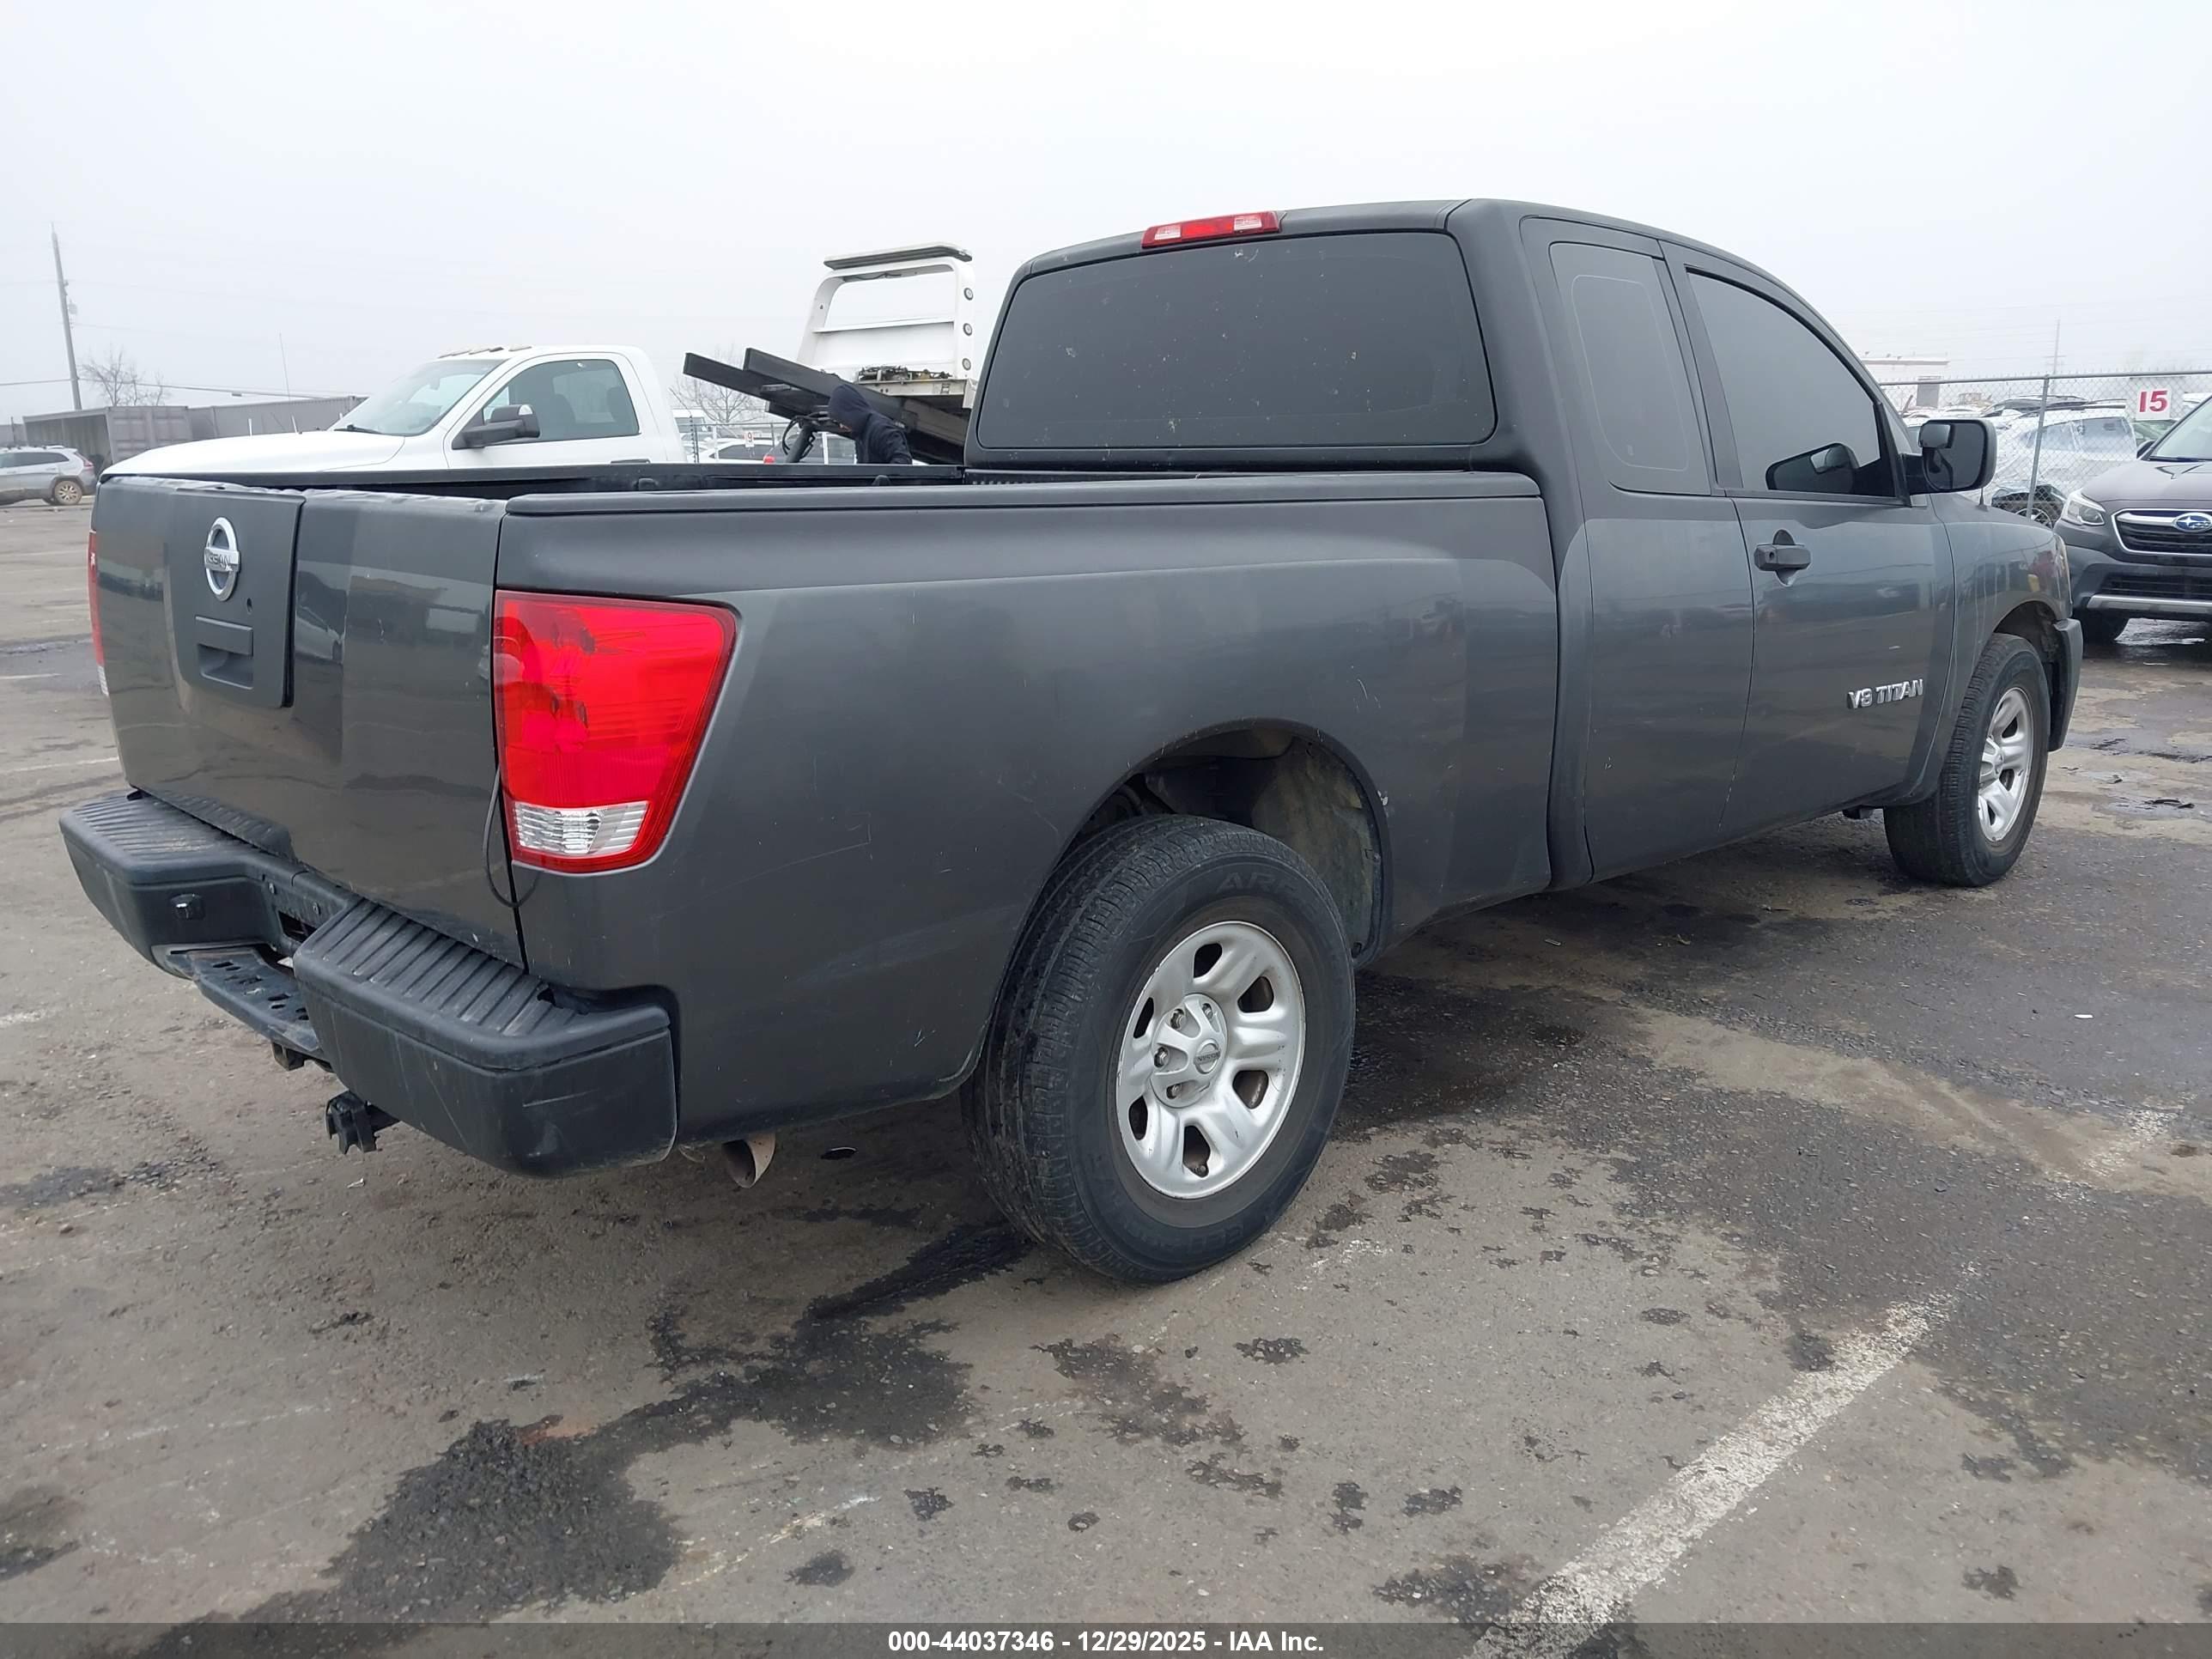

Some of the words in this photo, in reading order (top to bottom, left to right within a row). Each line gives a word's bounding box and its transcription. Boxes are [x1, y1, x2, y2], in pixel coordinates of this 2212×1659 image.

[2139, 391, 2168, 412] 15
[747, 431, 753, 442] 9
[1847, 689, 1872, 708] V8
[1875, 678, 1923, 703] TITAN
